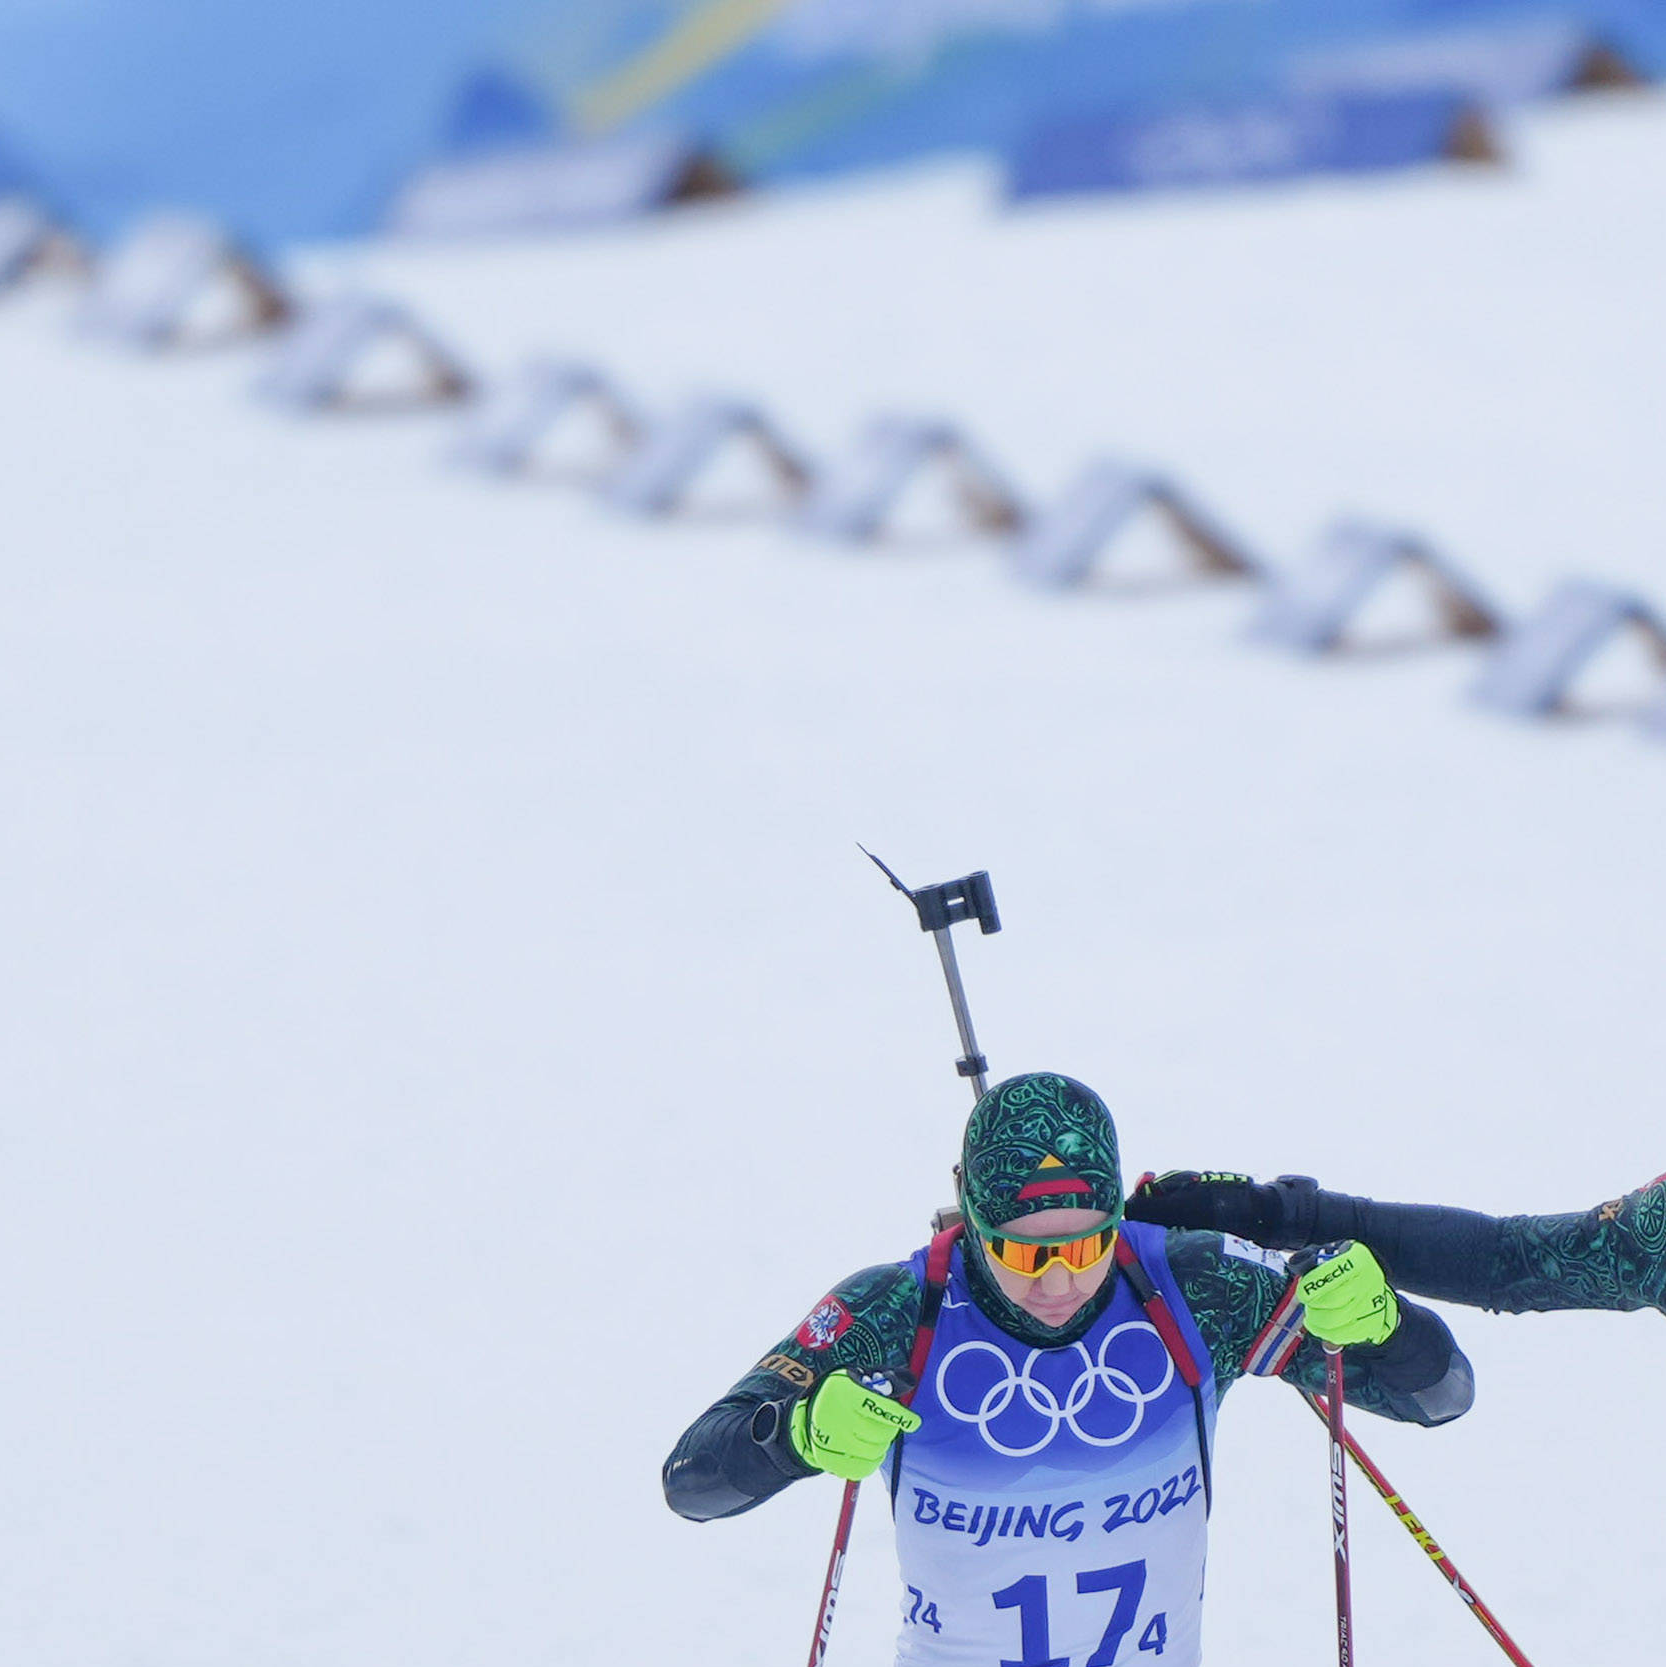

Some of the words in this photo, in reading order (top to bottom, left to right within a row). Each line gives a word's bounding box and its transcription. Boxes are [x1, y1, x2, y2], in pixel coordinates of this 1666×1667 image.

[1303, 1259, 1354, 1295] Roeckl
[861, 1398, 913, 1429] Roeckl
[913, 1487, 1084, 1547] BEIJING
[1101, 1465, 1202, 1533] 2022
[1384, 1493, 1446, 1561] LEKI
